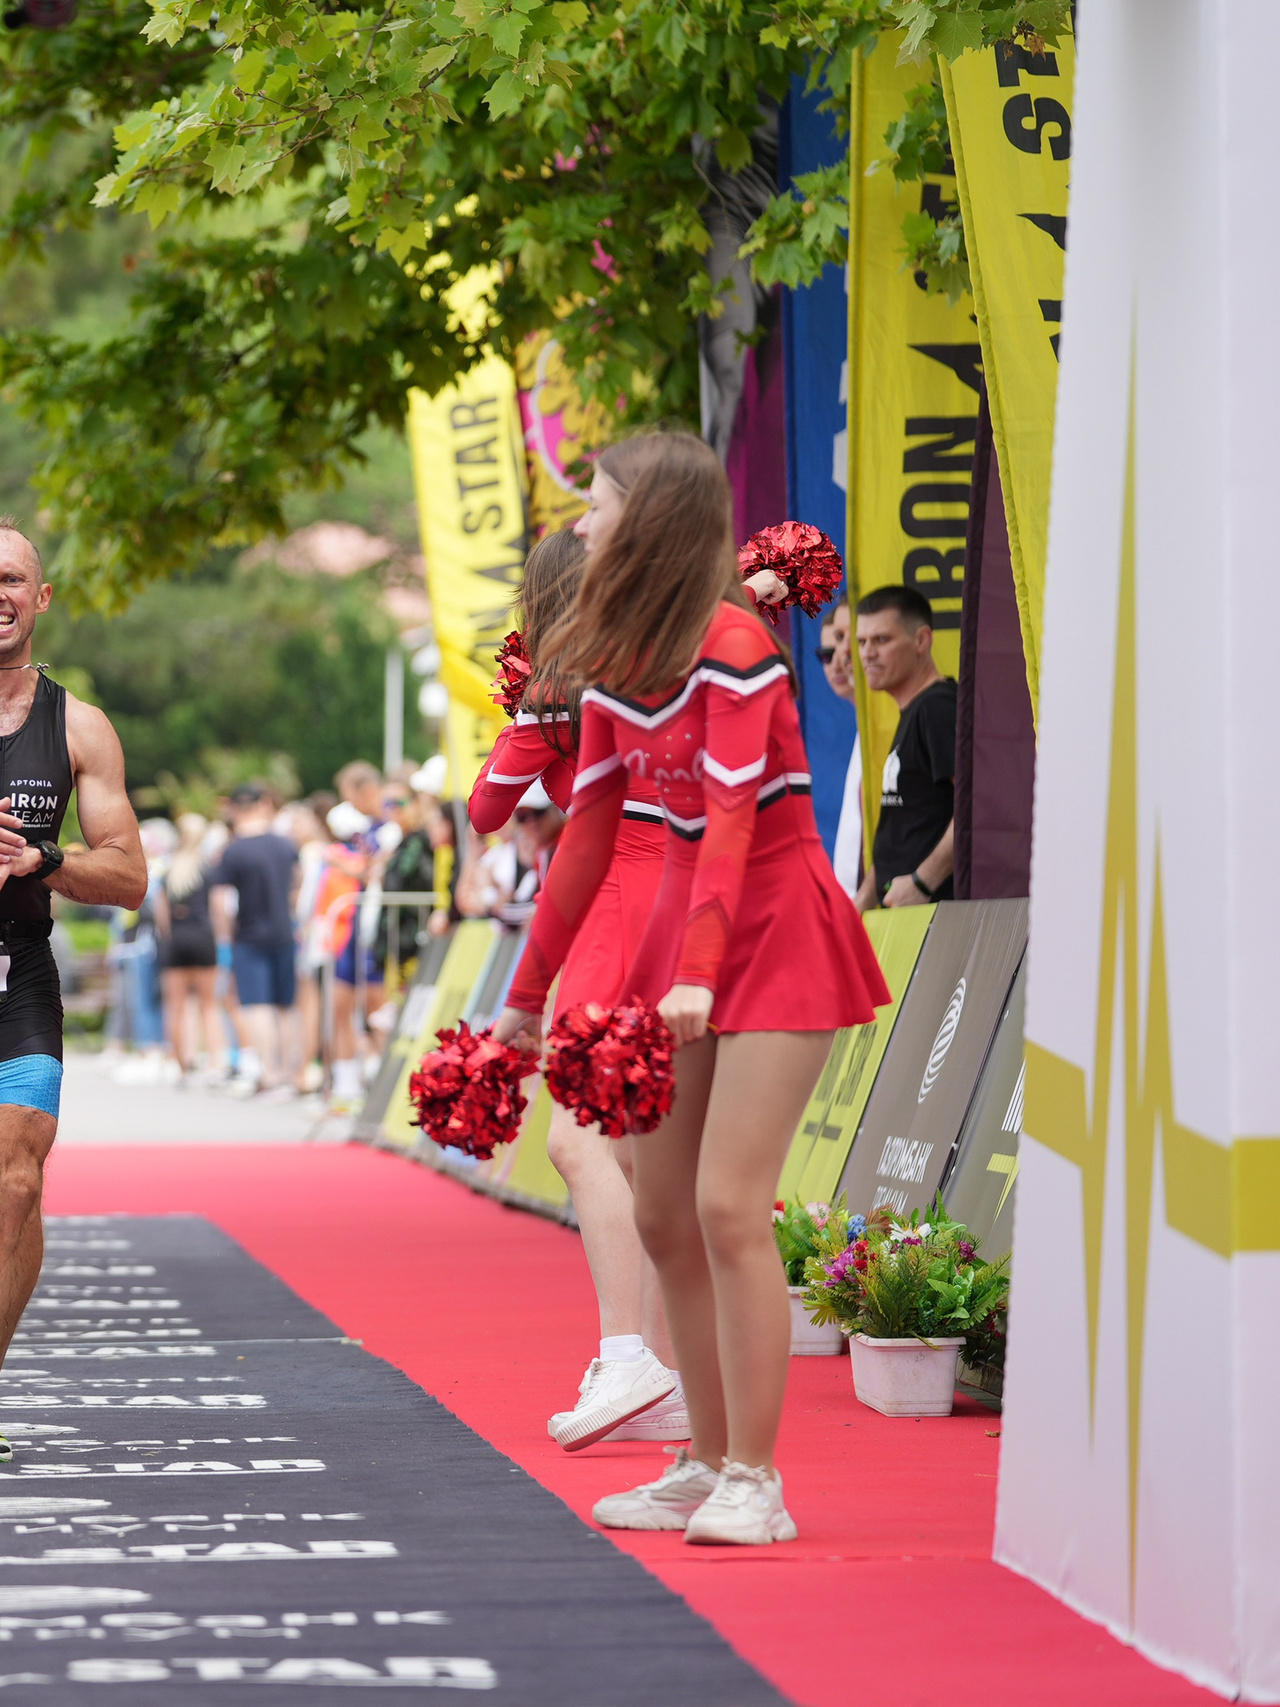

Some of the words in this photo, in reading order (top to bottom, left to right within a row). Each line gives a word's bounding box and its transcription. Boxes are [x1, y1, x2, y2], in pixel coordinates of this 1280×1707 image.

[450, 396, 505, 534] STAR
[10, 779, 52, 787] APTONIA
[11, 793, 58, 809] IRON
[11, 810, 55, 823] TEAM
[20, 1459, 326, 1474] STAR
[42, 1541, 398, 1558] STAR
[67, 1656, 498, 1683] STAR
